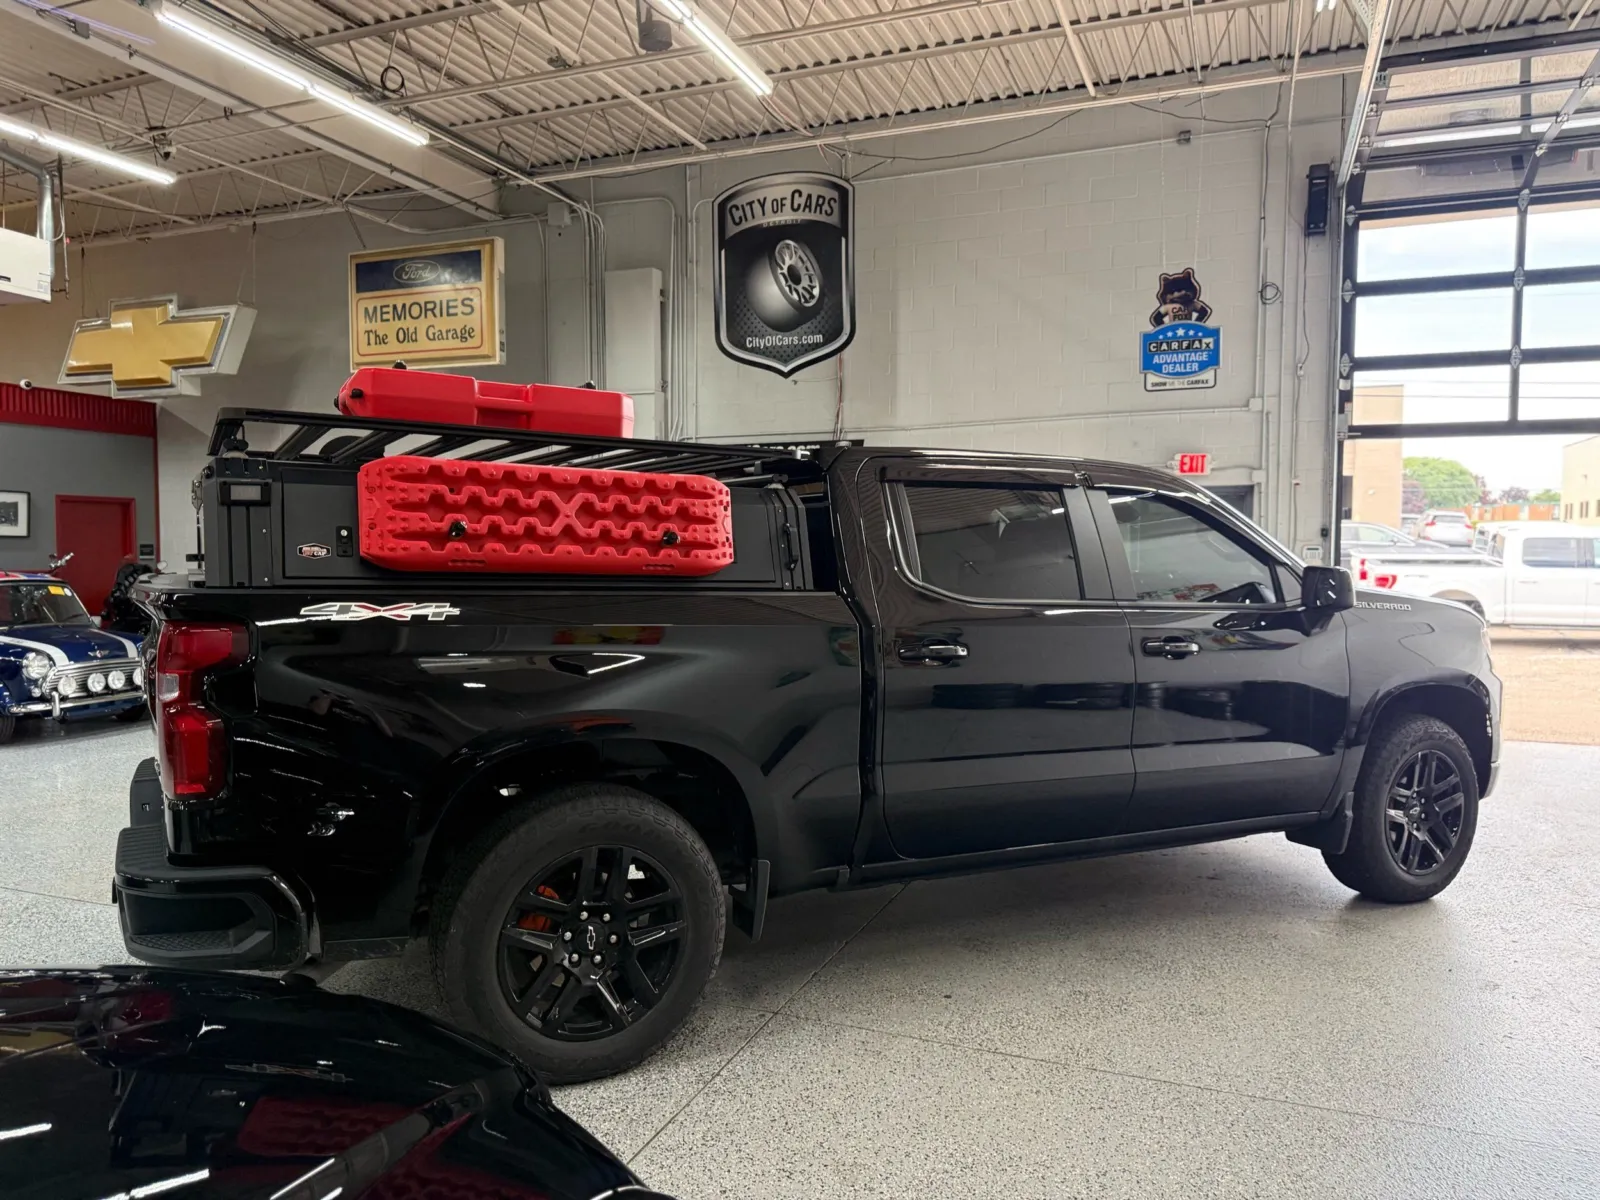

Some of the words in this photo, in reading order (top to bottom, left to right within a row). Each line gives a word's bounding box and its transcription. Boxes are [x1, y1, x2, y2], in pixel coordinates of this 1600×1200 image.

[728, 196, 767, 227] CITY
[771, 197, 787, 214] OF
[790, 189, 838, 217] CARS
[401, 262, 432, 280] Ford
[363, 297, 475, 325] MEMORIES
[364, 329, 389, 346] The
[396, 326, 418, 344] Old
[425, 325, 476, 343] Garage
[746, 332, 823, 350] CityOfCars.com
[1149, 340, 1213, 352] CARFAX
[1152, 351, 1209, 364] ADVANTAGE
[1162, 363, 1199, 374] DEALER
[1180, 454, 1206, 473] EXIT
[1355, 601, 1412, 611] SILVERADO
